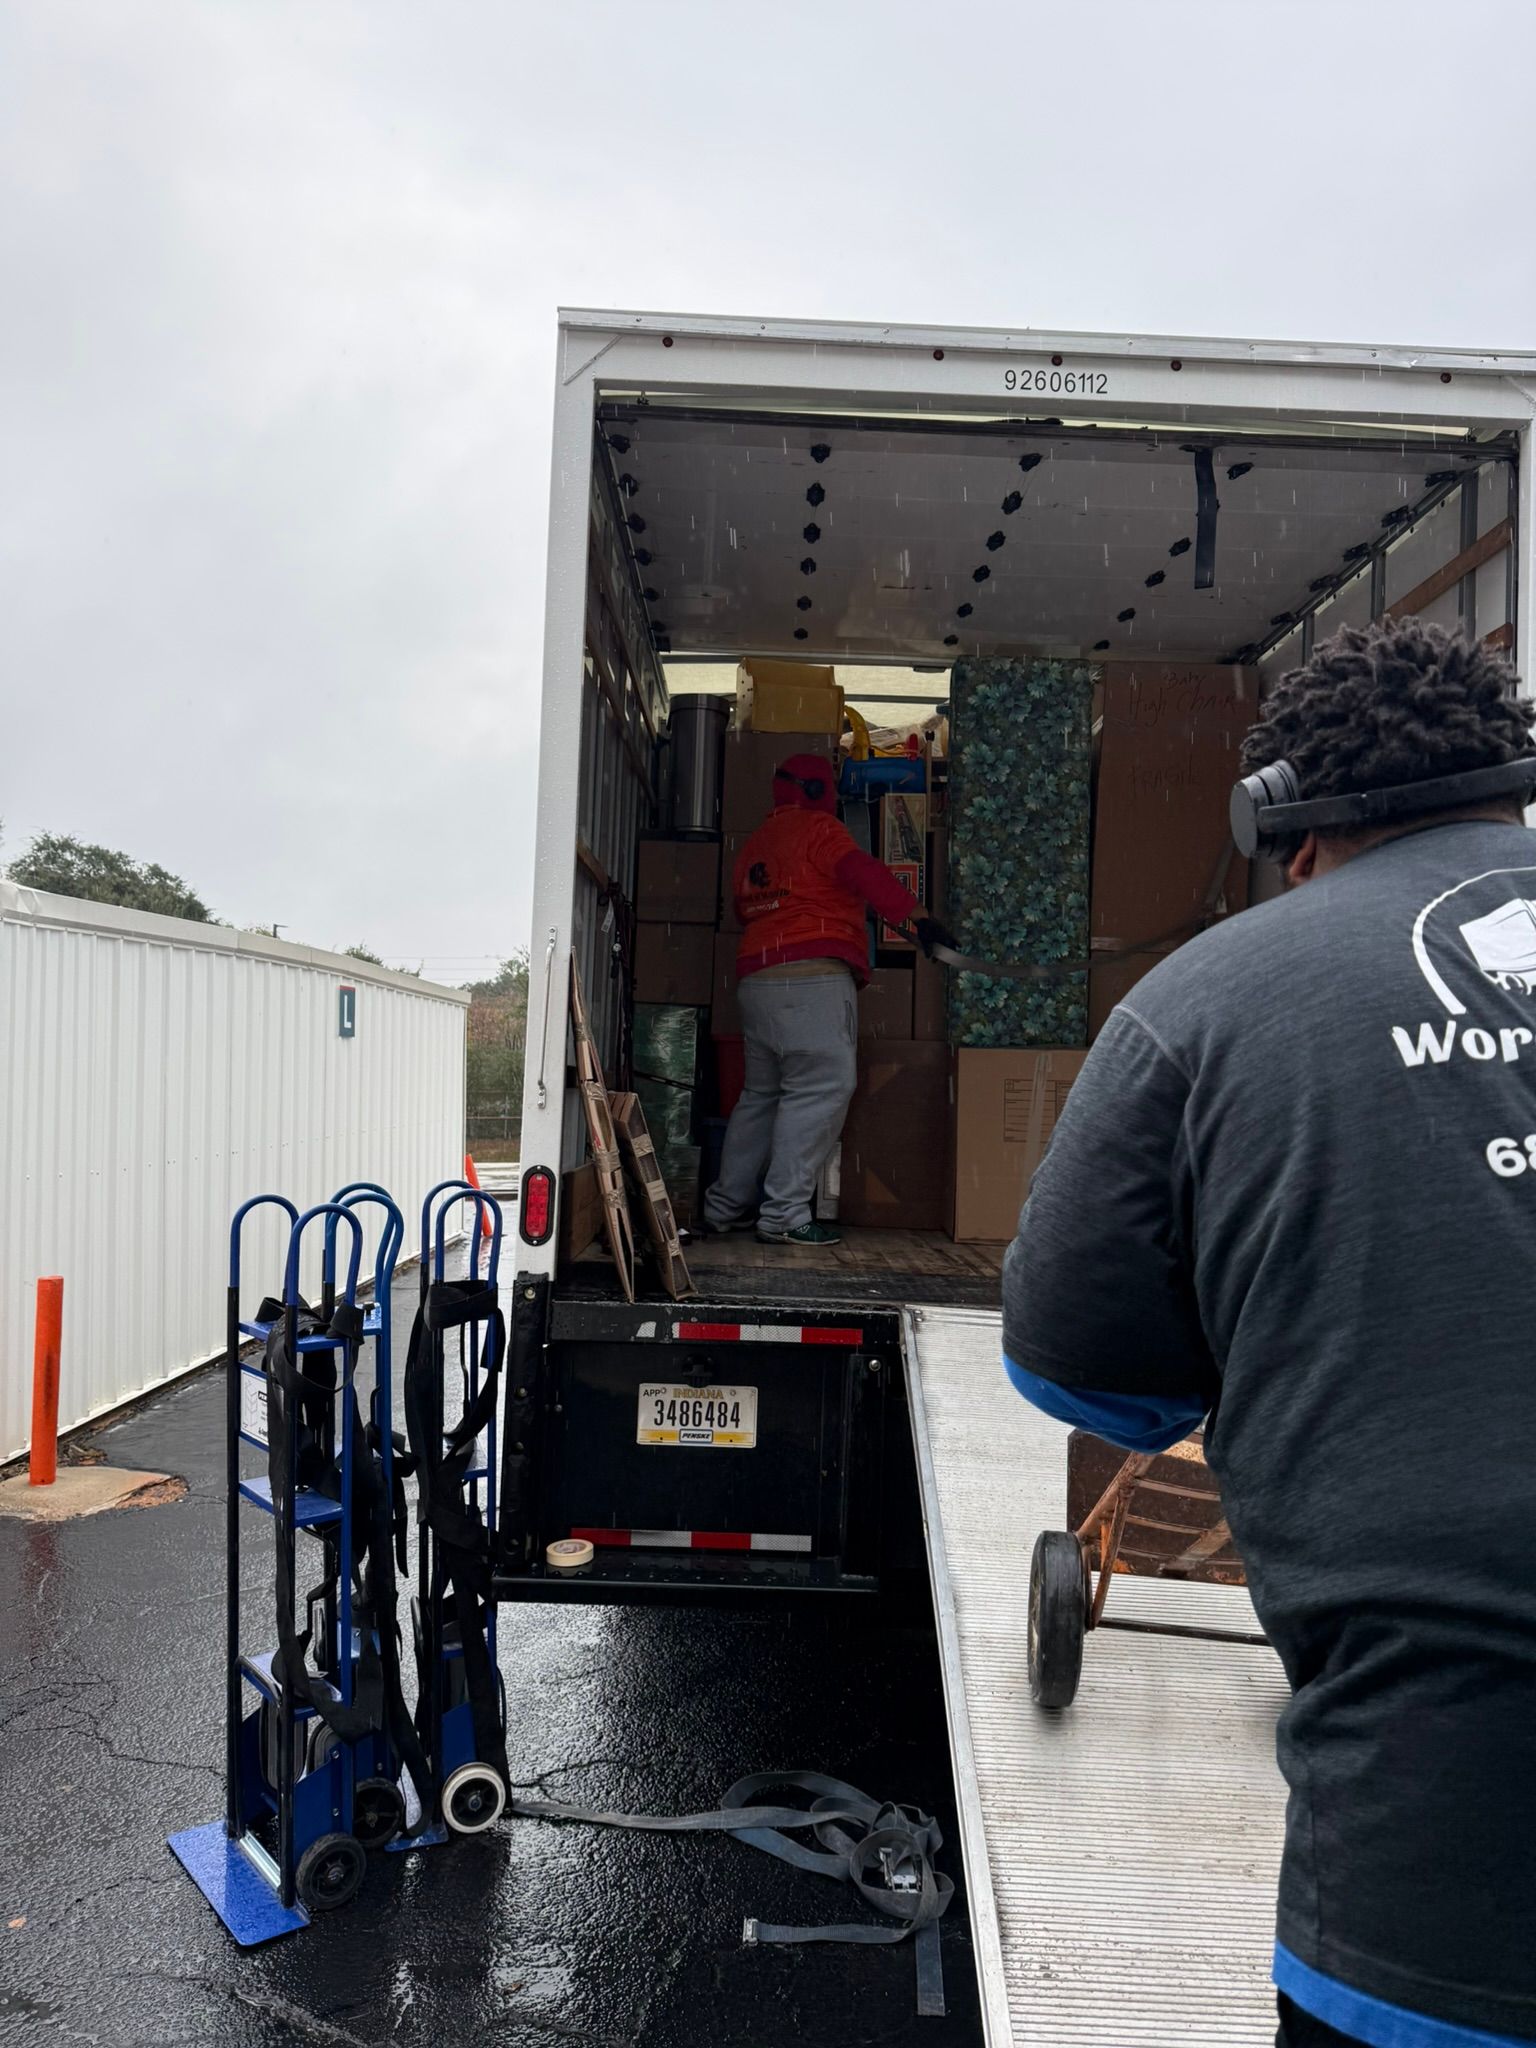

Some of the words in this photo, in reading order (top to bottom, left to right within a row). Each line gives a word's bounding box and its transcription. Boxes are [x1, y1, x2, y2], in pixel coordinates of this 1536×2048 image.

[1004, 369, 1108, 394] 92606112
[344, 995, 352, 1028] L
[1391, 1020, 1536, 1067] Wor
[642, 1388, 660, 1397] APP
[672, 1388, 725, 1400] INDIANA
[653, 1399, 740, 1429] 3486484
[681, 1432, 712, 1440] PENSKE
